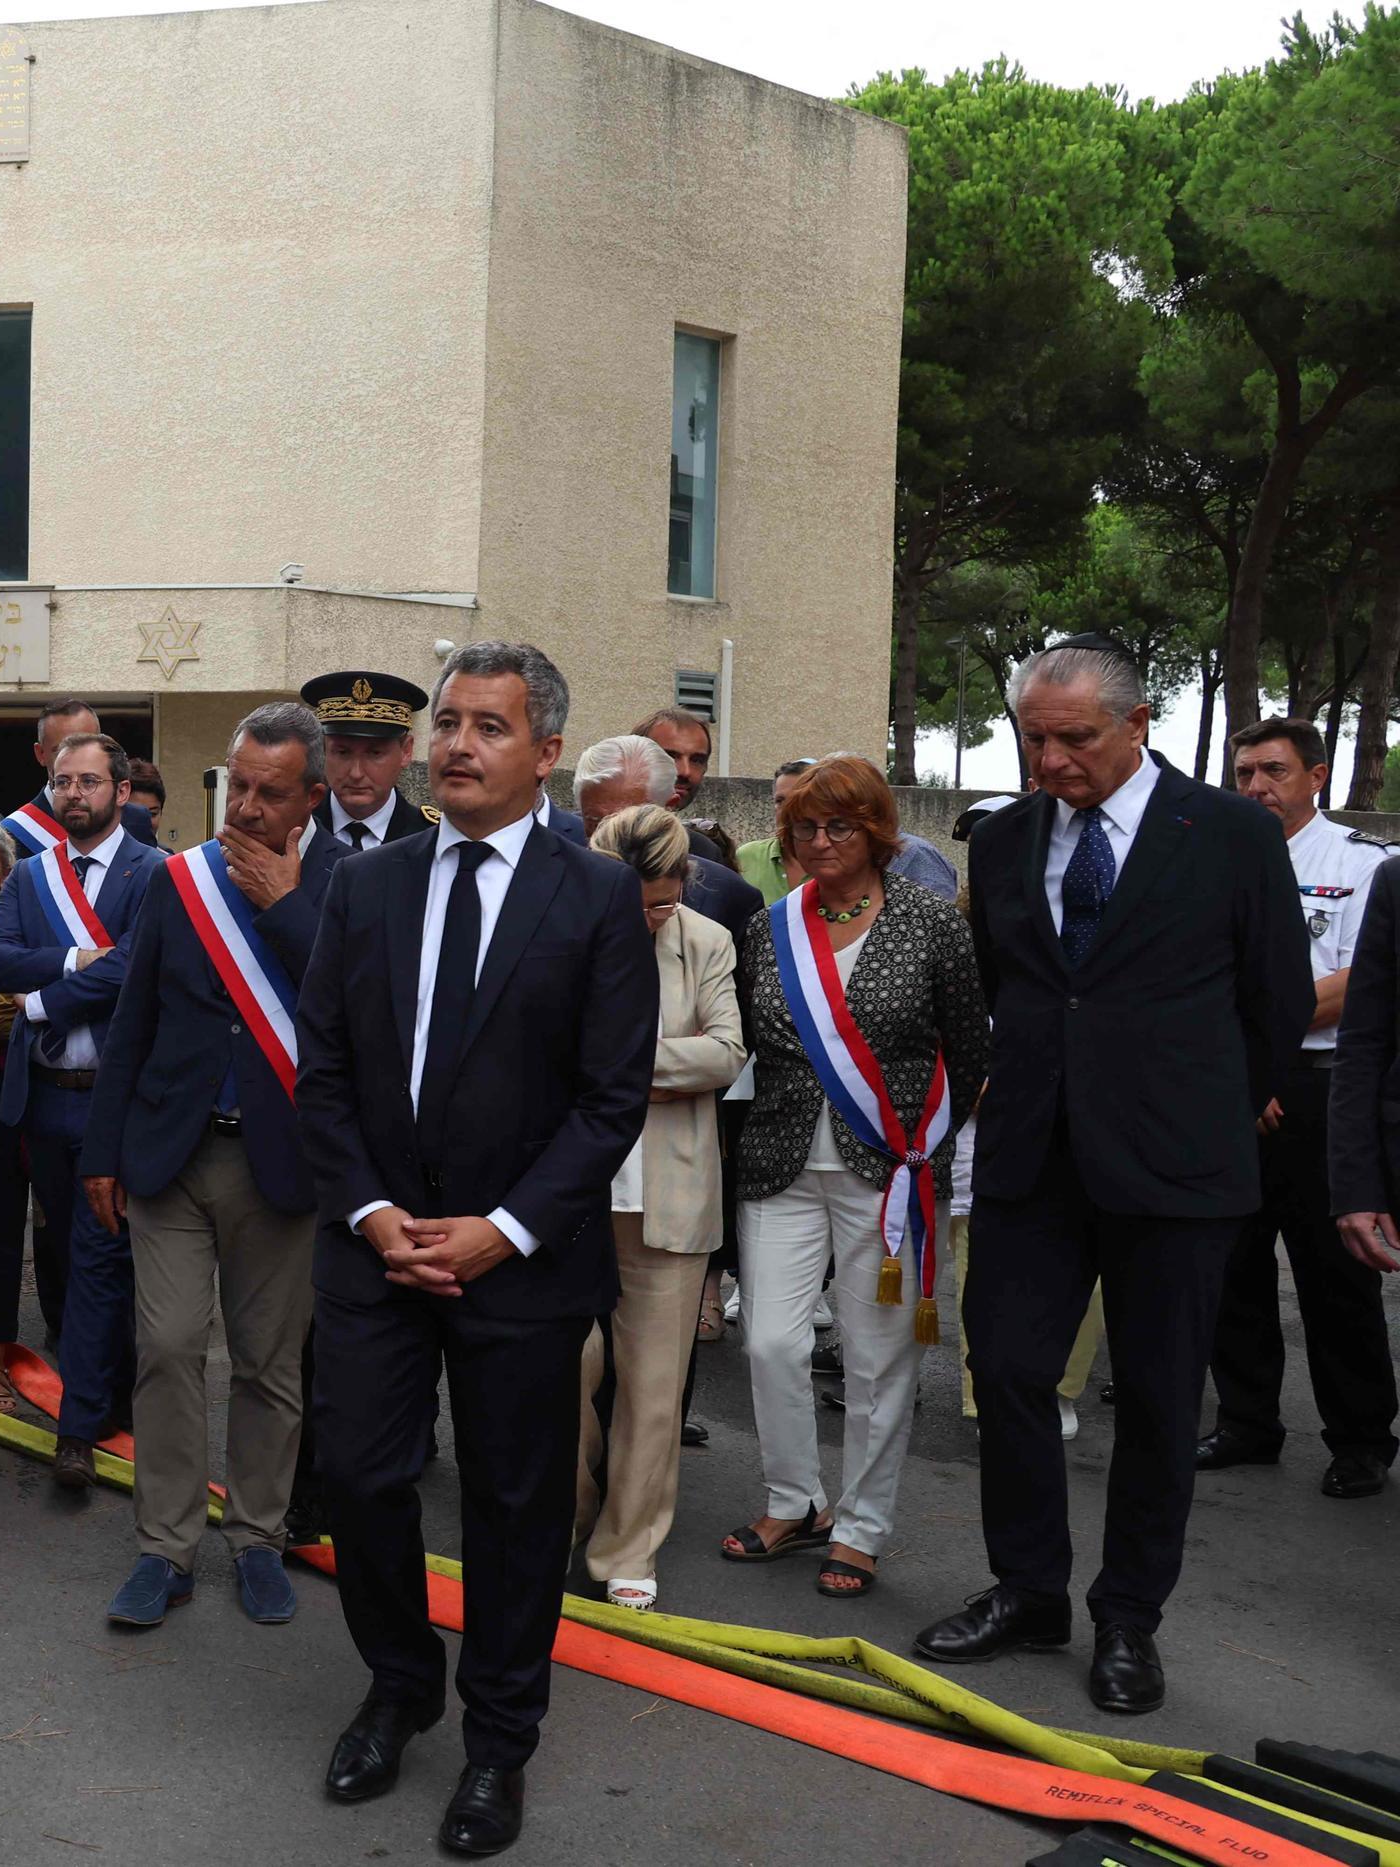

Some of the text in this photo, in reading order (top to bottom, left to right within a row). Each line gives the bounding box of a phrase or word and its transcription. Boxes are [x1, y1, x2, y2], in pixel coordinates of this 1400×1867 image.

[1045, 1785, 1269, 1861] REMIFLEX SPECIAL FLUO
